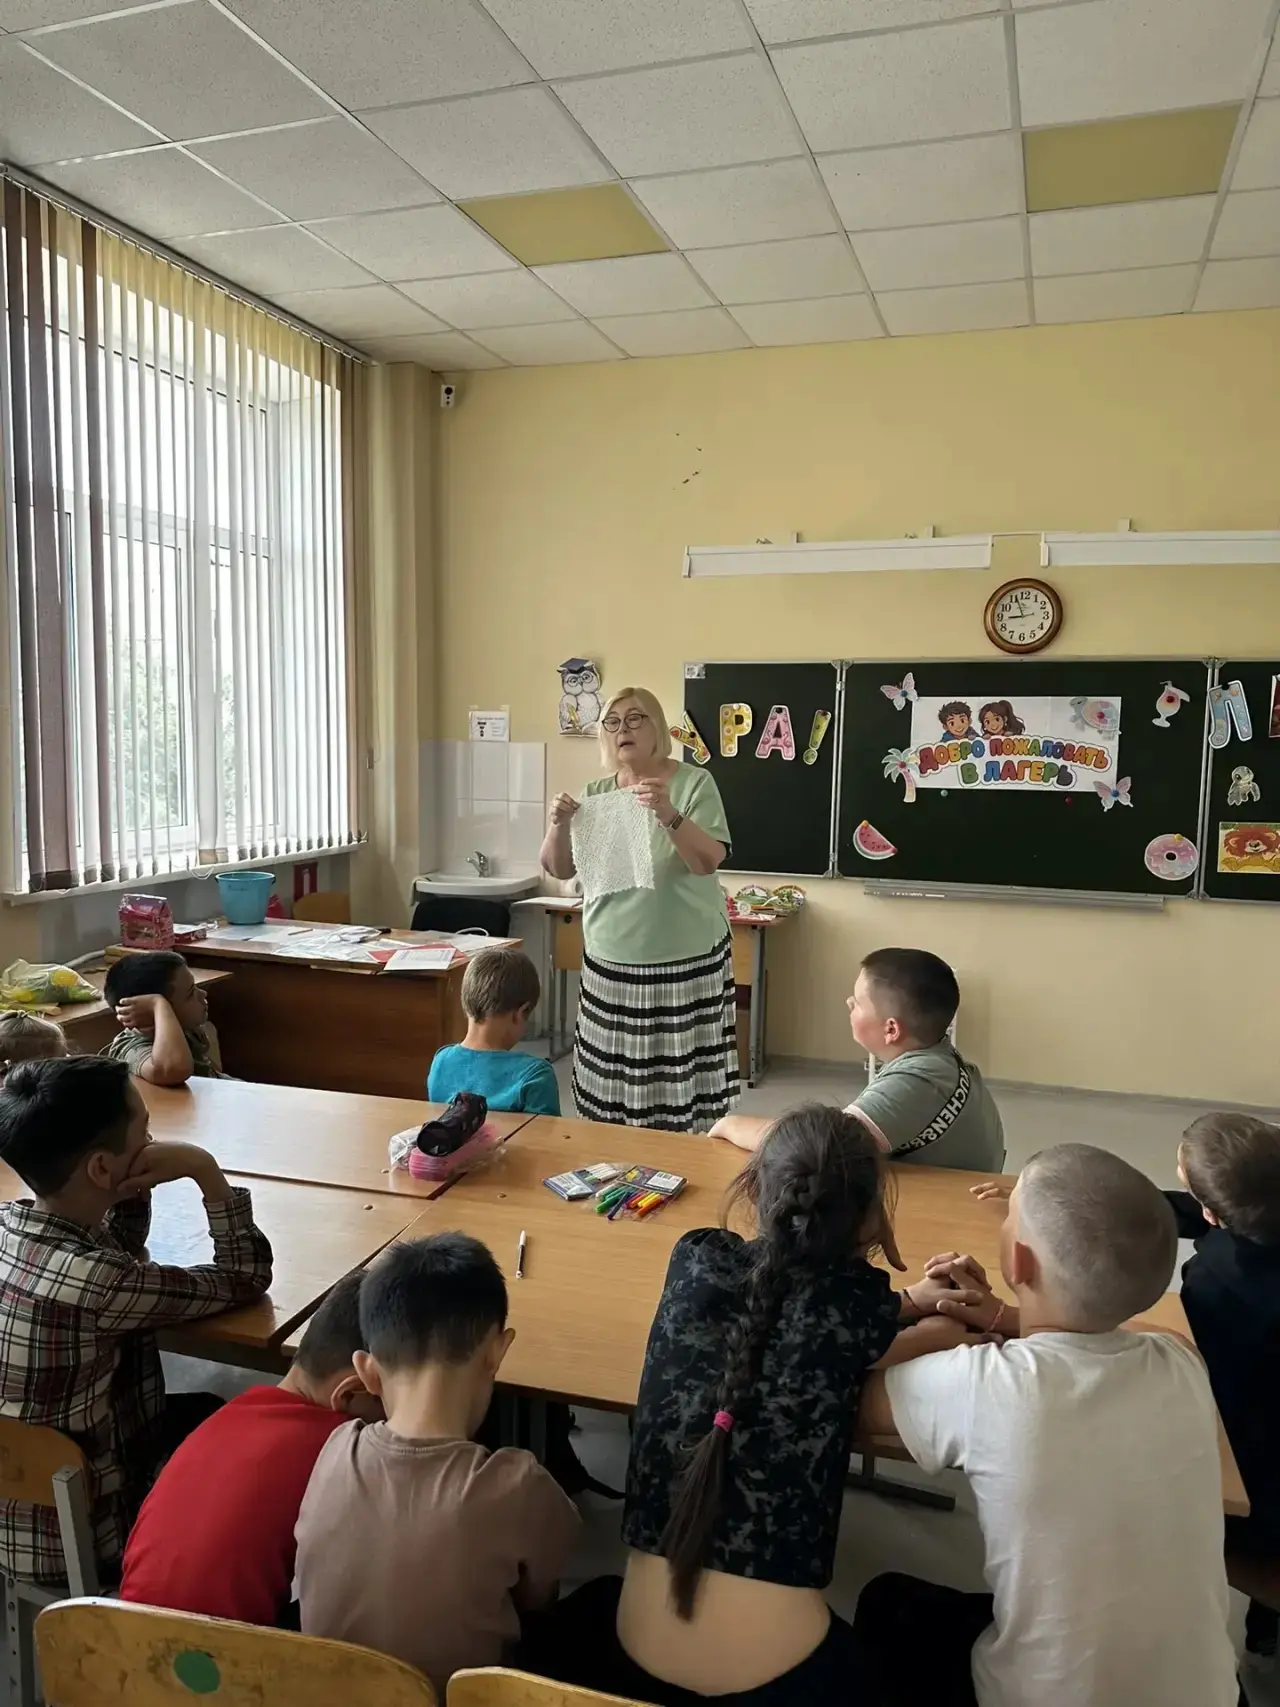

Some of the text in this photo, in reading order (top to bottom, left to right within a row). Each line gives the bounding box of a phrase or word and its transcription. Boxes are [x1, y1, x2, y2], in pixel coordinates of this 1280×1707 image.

[1010, 595, 1018, 603] 11
[1020, 591, 1031, 600] 12
[1034, 595, 1038, 603] 1
[1001, 603, 1011, 612] 10
[1040, 601, 1046, 610] 2
[997, 613, 1004, 621] 9
[1043, 611, 1049, 620] 3
[1000, 623, 1007, 632] 8
[1038, 622, 1044, 630] 4
[1009, 630, 1015, 639] 7
[1019, 633, 1025, 641] 6
[1030, 630, 1036, 638] 5
[919, 737, 1109, 774] ДОБРО ПОЖАЛОВАТЬ
[961, 760, 1073, 786] В ЛАГЕРЬ
